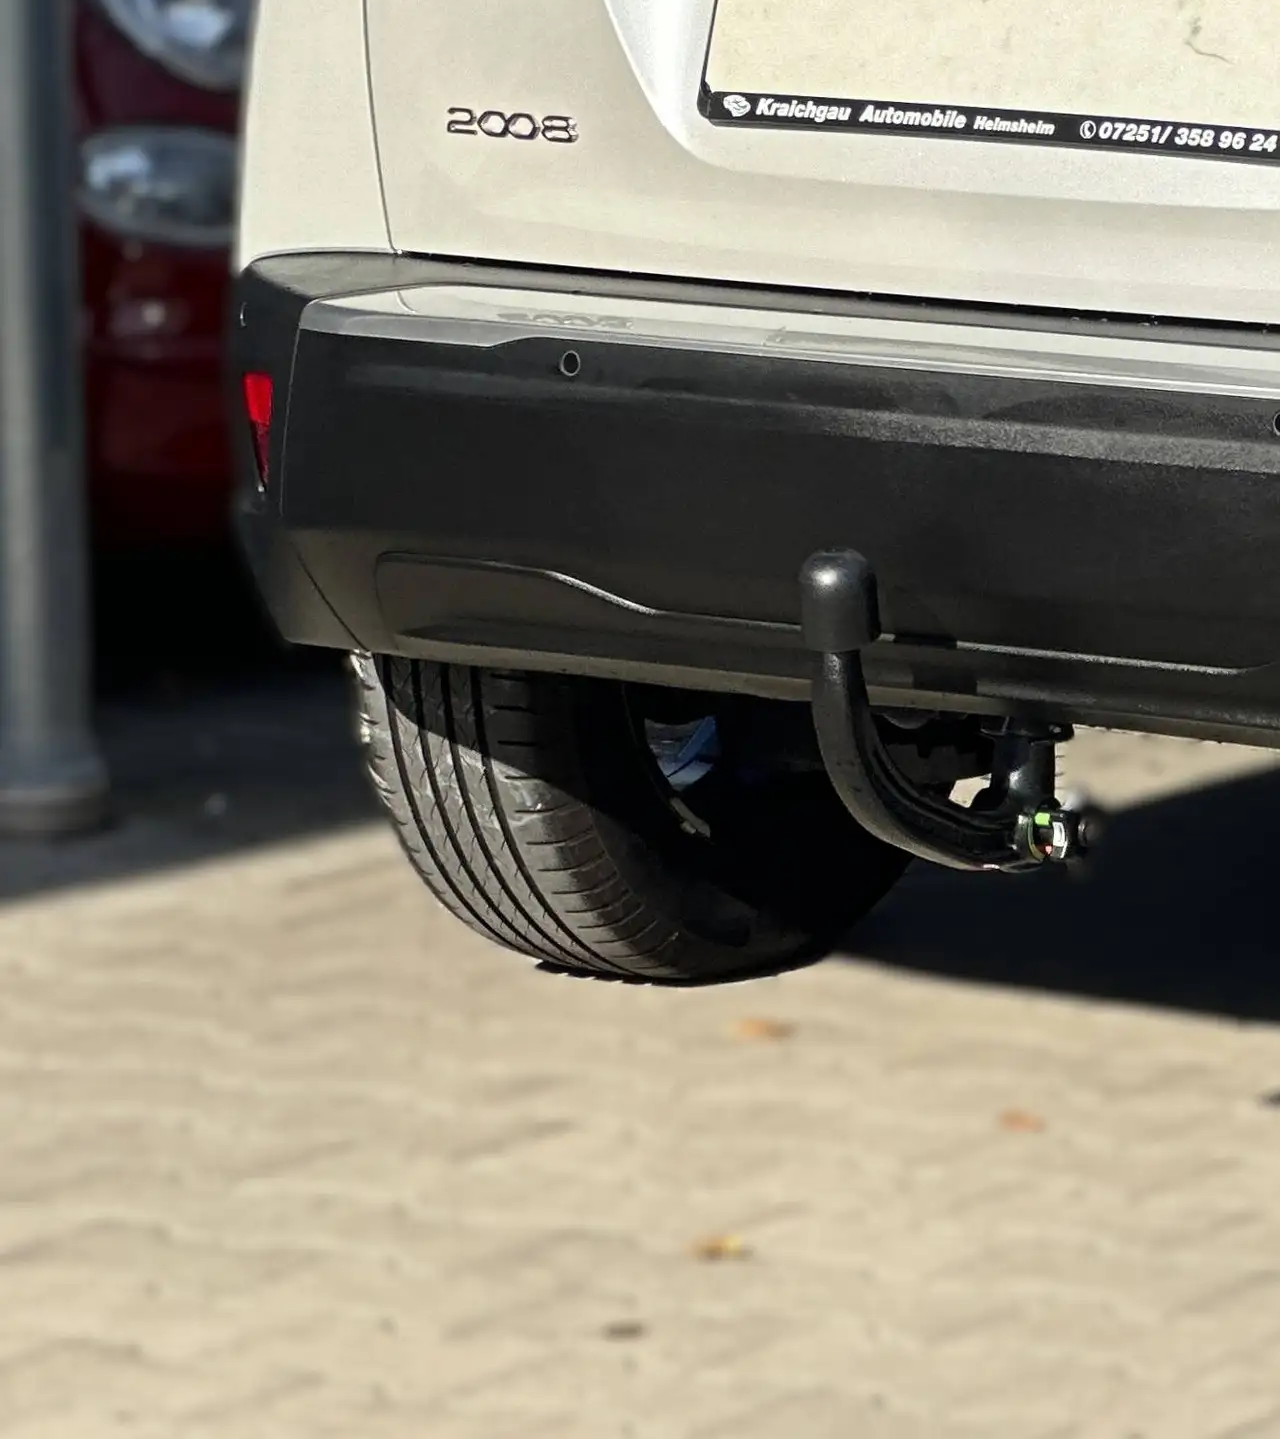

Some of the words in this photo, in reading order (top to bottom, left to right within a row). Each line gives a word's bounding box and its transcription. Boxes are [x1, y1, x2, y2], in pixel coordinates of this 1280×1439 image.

[447, 107, 580, 143] 2008
[755, 98, 852, 122] Kraichgau
[858, 105, 968, 129] Automobile
[1099, 120, 1173, 144] 07251/
[1174, 126, 1215, 148] 358
[1218, 130, 1247, 151] 96
[1249, 133, 1279, 153] 24
